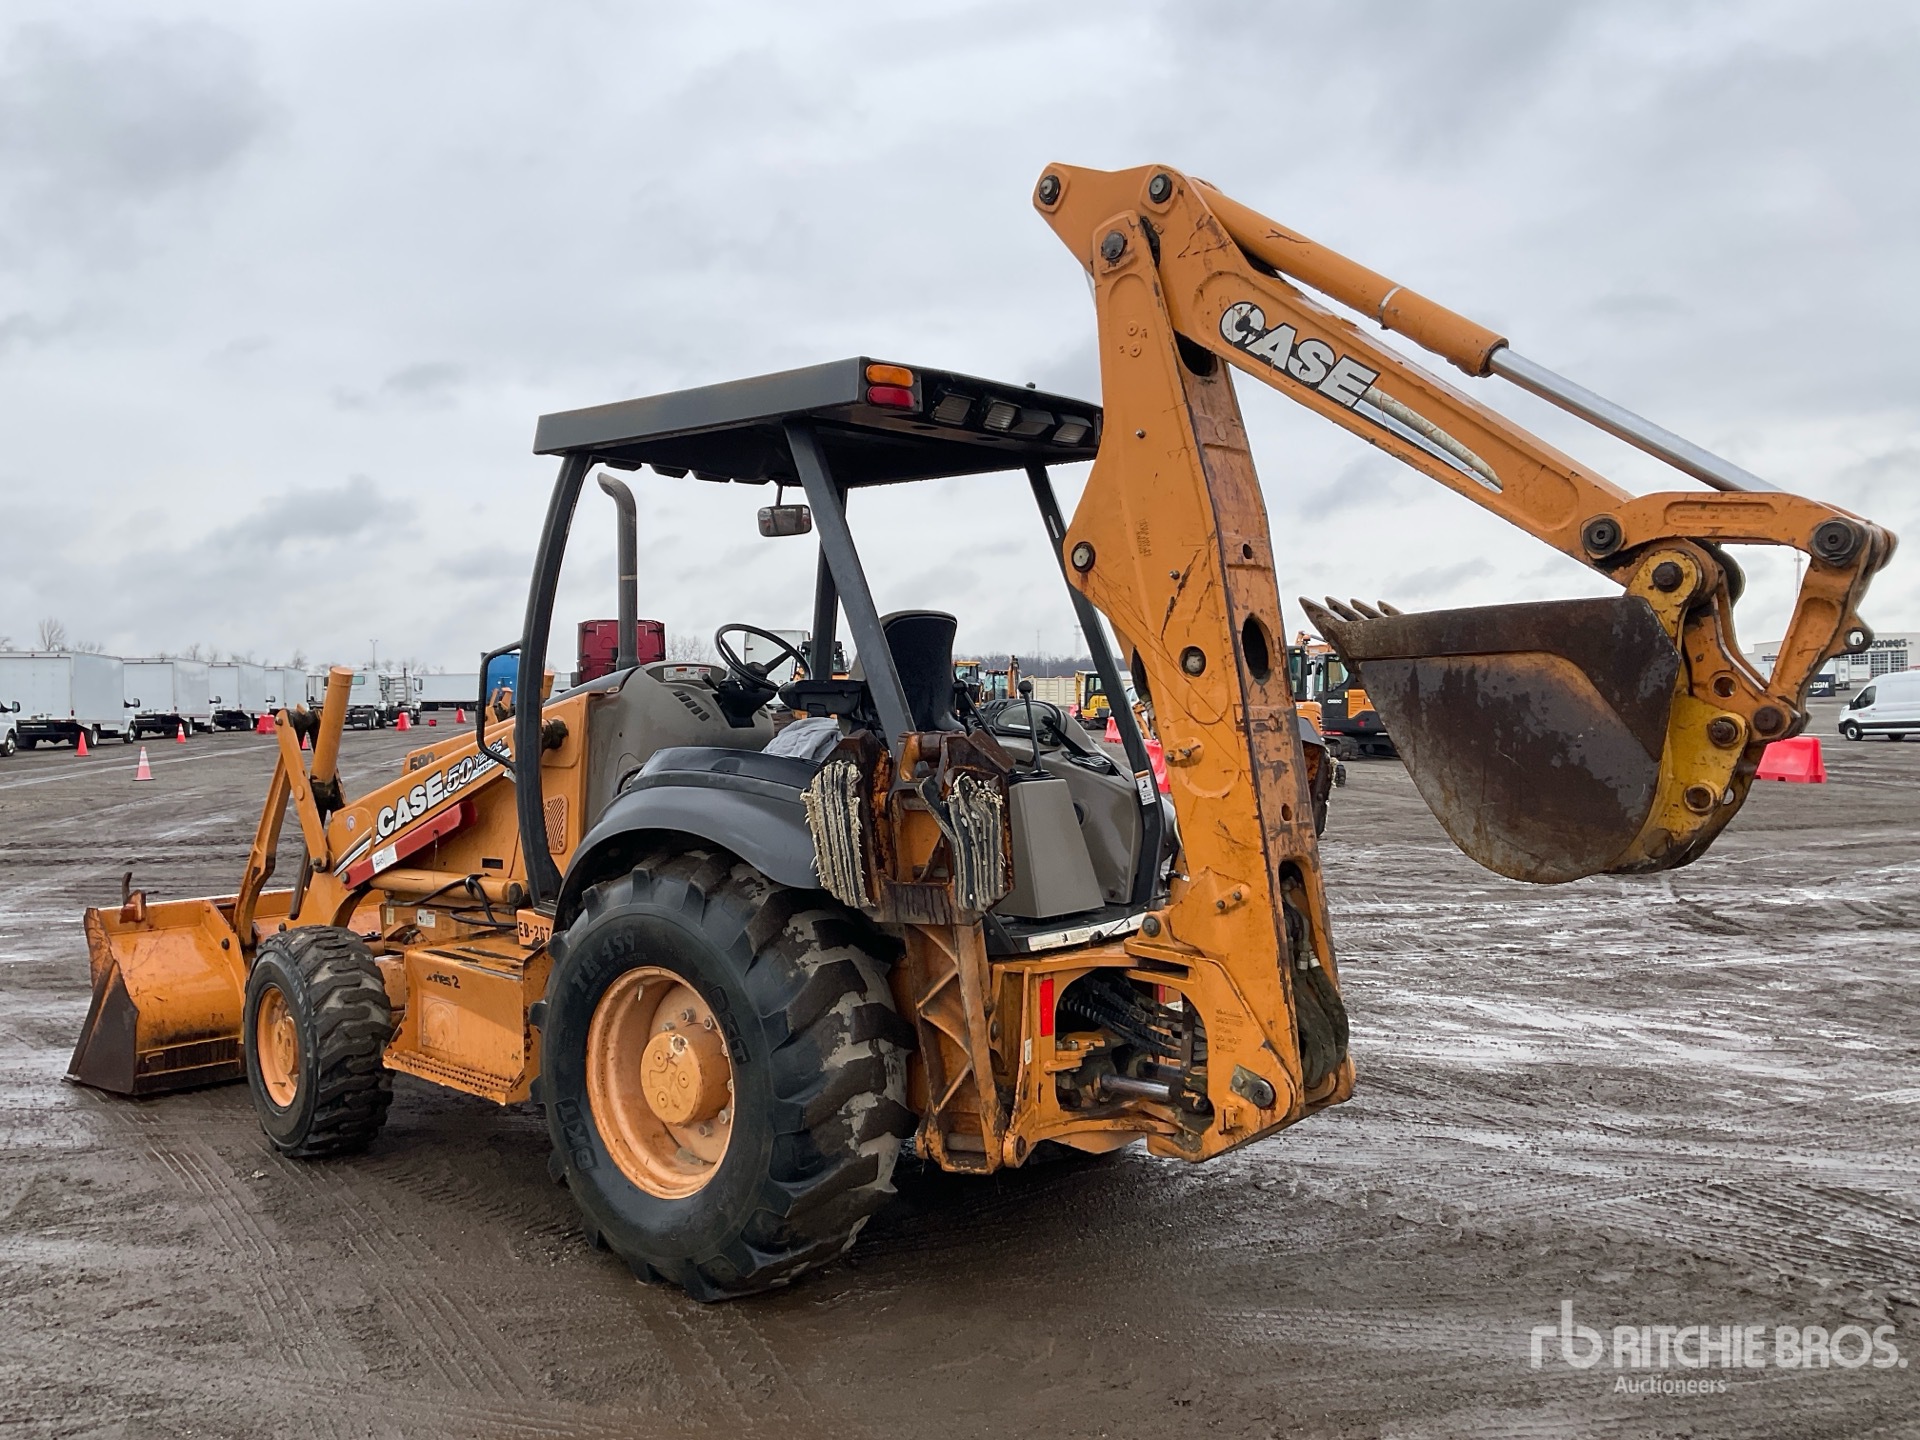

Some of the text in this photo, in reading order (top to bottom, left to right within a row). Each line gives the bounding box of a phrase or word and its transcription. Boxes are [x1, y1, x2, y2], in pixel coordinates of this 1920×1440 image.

[1219, 301, 1381, 409] CASE
[377, 770, 444, 838] CASE
[446, 756, 473, 793] 50
[474, 738, 502, 770] YERS
[601, 928, 635, 961] 459
[452, 974, 461, 989] 2
[556, 1101, 597, 1171] BKT
